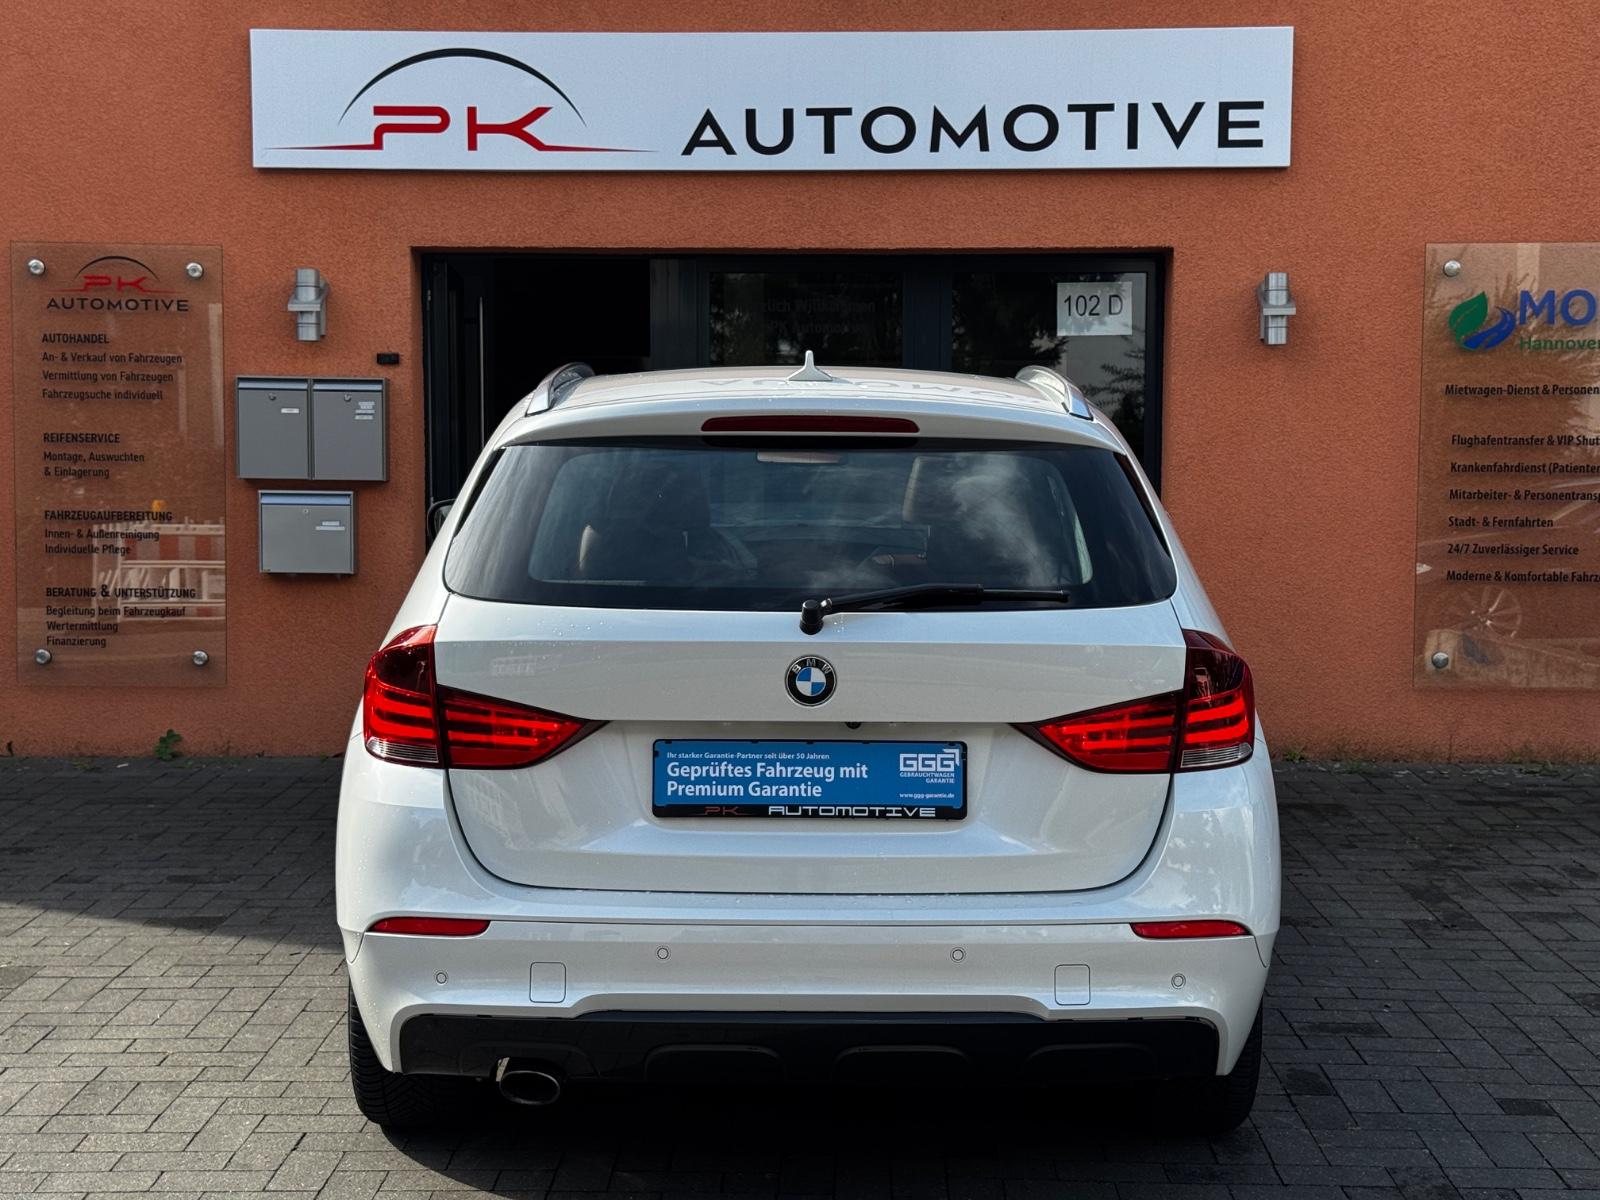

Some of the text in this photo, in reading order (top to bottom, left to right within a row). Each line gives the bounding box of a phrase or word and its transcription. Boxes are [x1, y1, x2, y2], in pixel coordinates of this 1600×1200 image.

[373, 101, 1264, 157] PK AUTOMOTIVE
[83, 275, 147, 292] PK
[46, 297, 189, 312] AUTOMOTIVE
[1064, 294, 1124, 317] 102 D
[1519, 289, 1597, 326] MO
[42, 333, 109, 344] AUTOHANDEL
[42, 352, 182, 366] An- & Verkauf von Fahrzeugen
[42, 371, 173, 384] Vermittlung von Fahrzeugen
[42, 389, 163, 401] Fahrzeugsuche individuell
[1445, 384, 1599, 396] Mietwagen-Dienst & Personen
[43, 433, 120, 443] REIFENSERVICE
[1451, 435, 1544, 448] Flughafentransfer
[1547, 435, 1554, 445] &
[1557, 435, 1574, 445] VIP
[43, 452, 145, 464] Montage, Auswuchten
[44, 467, 110, 479] & Einlagerung
[1450, 462, 1547, 474] Krankenfahrdienst
[1449, 489, 1512, 500] Mitarbeiter-
[1514, 490, 1522, 500] &
[44, 510, 173, 521] FAHRZEUGAUFBEREITUNG
[1448, 516, 1553, 528] Stadt- & Fernfahrten
[44, 529, 160, 541] Innen- & Außenreinigung
[44, 543, 131, 555] Individuelle Pflege
[1447, 543, 1579, 556] 24/7 Zuverlässiger Service
[1446, 570, 1492, 582] Moderne
[1494, 571, 1502, 582] &
[1504, 571, 1569, 583] Komfortable
[46, 584, 196, 598] BERATUNG & UNTERSTÜTZUNG
[46, 606, 186, 618] Begleitung beim Fahrzeugkauf
[46, 621, 119, 633] Wertermittlung
[46, 636, 107, 648] Finanzierung
[792, 658, 832, 674] BMW
[778, 752, 795, 760] über
[899, 753, 955, 772] GGG
[667, 761, 868, 782] Geprüftes Fahrzeug mit
[667, 781, 822, 797] Premium Garantie
[705, 806, 936, 817] PK AUTOMOTIVE
